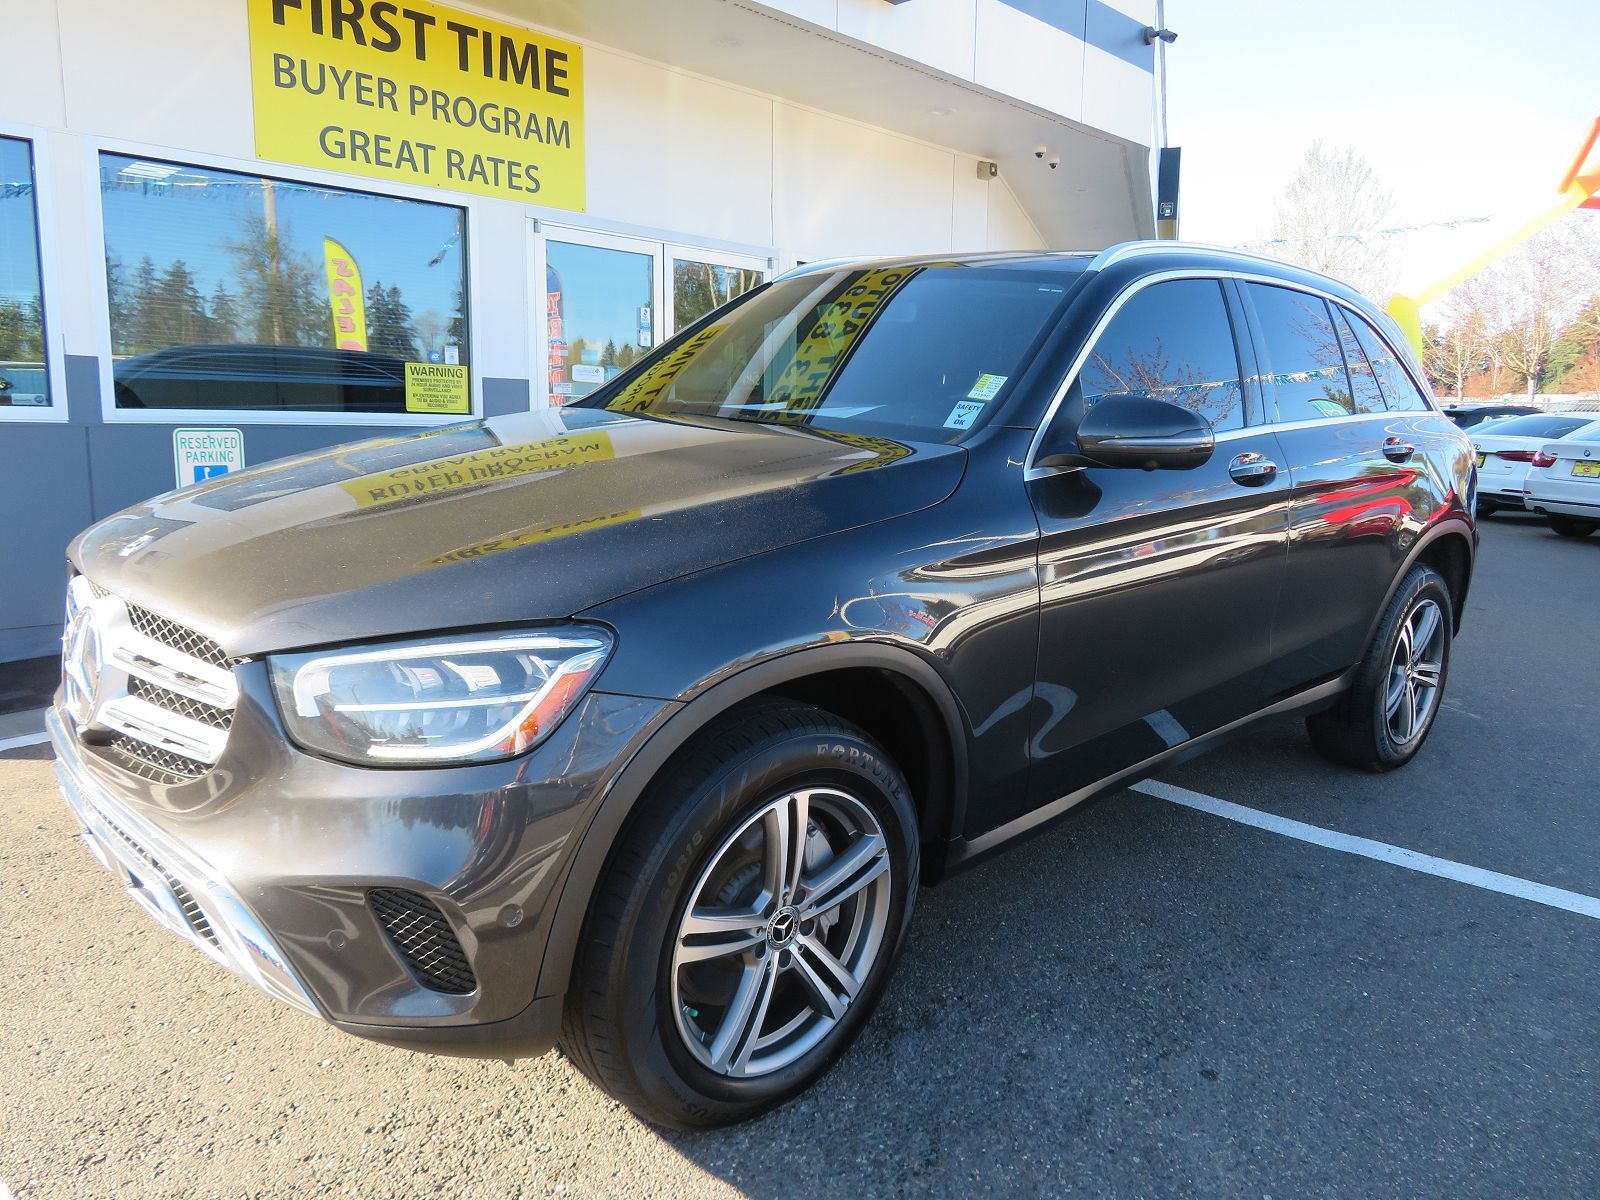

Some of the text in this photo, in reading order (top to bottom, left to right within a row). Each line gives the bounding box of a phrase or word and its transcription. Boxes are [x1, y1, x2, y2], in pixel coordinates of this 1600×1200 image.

[447, 20, 570, 97] TIME
[272, 52, 571, 149] BUYER PROGRAM
[319, 125, 542, 194] GREAT RATES
[409, 366, 464, 379] WARNING
[956, 403, 980, 411] SAFETY
[180, 437, 238, 449] RESERVED
[185, 450, 234, 463] PARKING
[815, 743, 902, 801] FORTUNE
